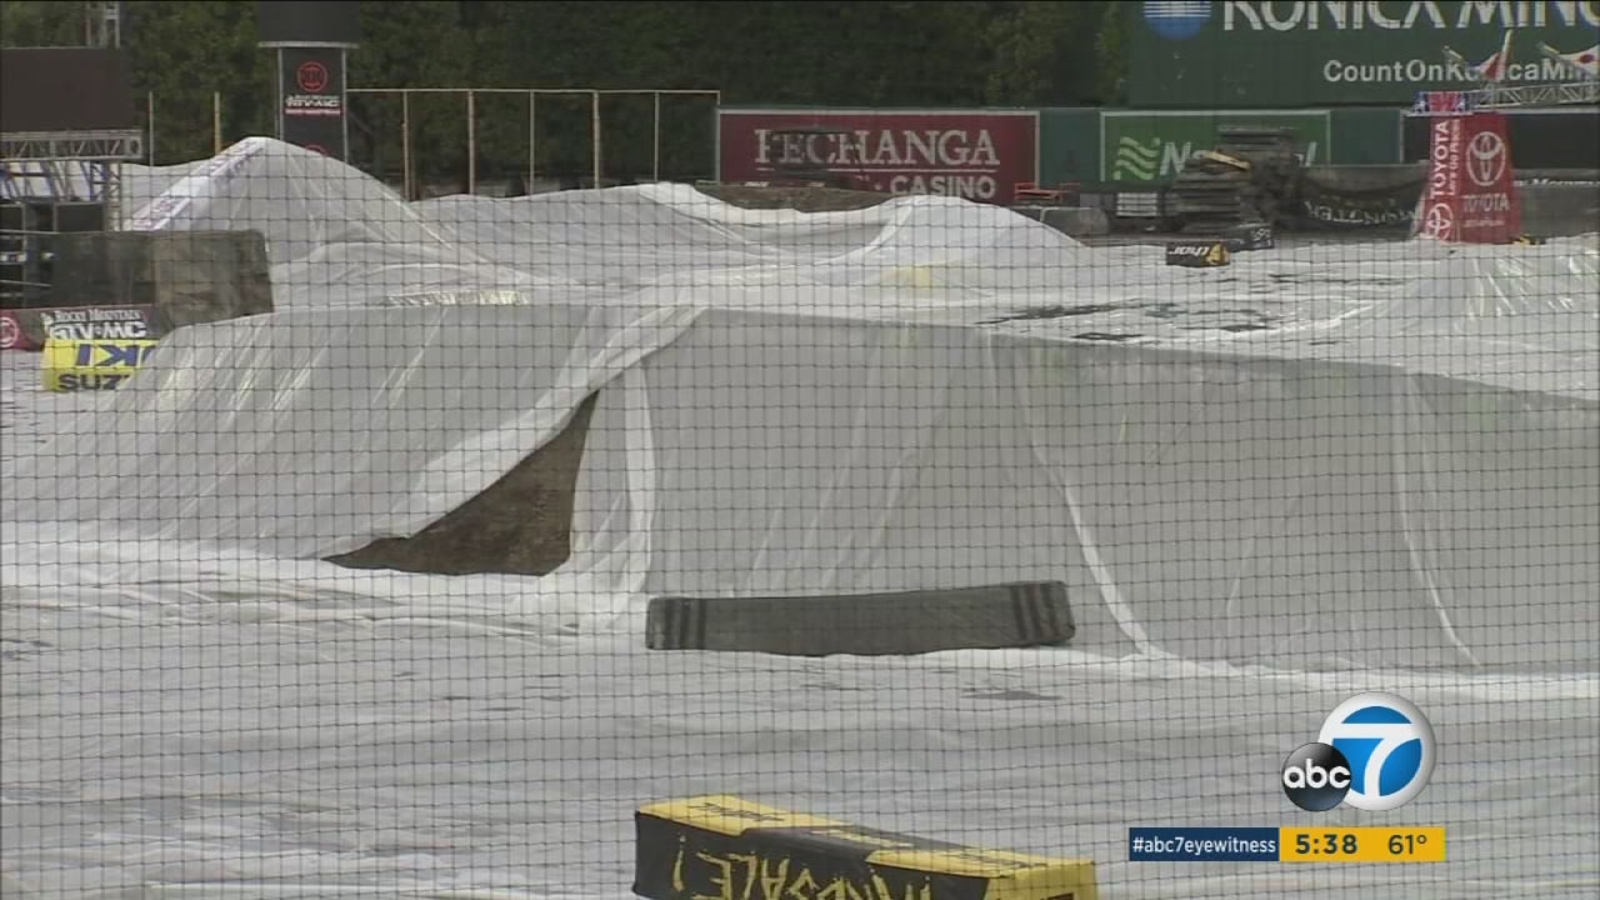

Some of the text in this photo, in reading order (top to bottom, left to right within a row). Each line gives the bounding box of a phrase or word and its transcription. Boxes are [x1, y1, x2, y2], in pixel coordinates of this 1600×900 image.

[1224, 0, 1600, 30] KONICA MIN
[1430, 120, 1449, 199] TOYOTA
[889, 174, 996, 199] CASINO
[1464, 193, 1509, 212] TOYOTA
[74, 344, 157, 367] KI
